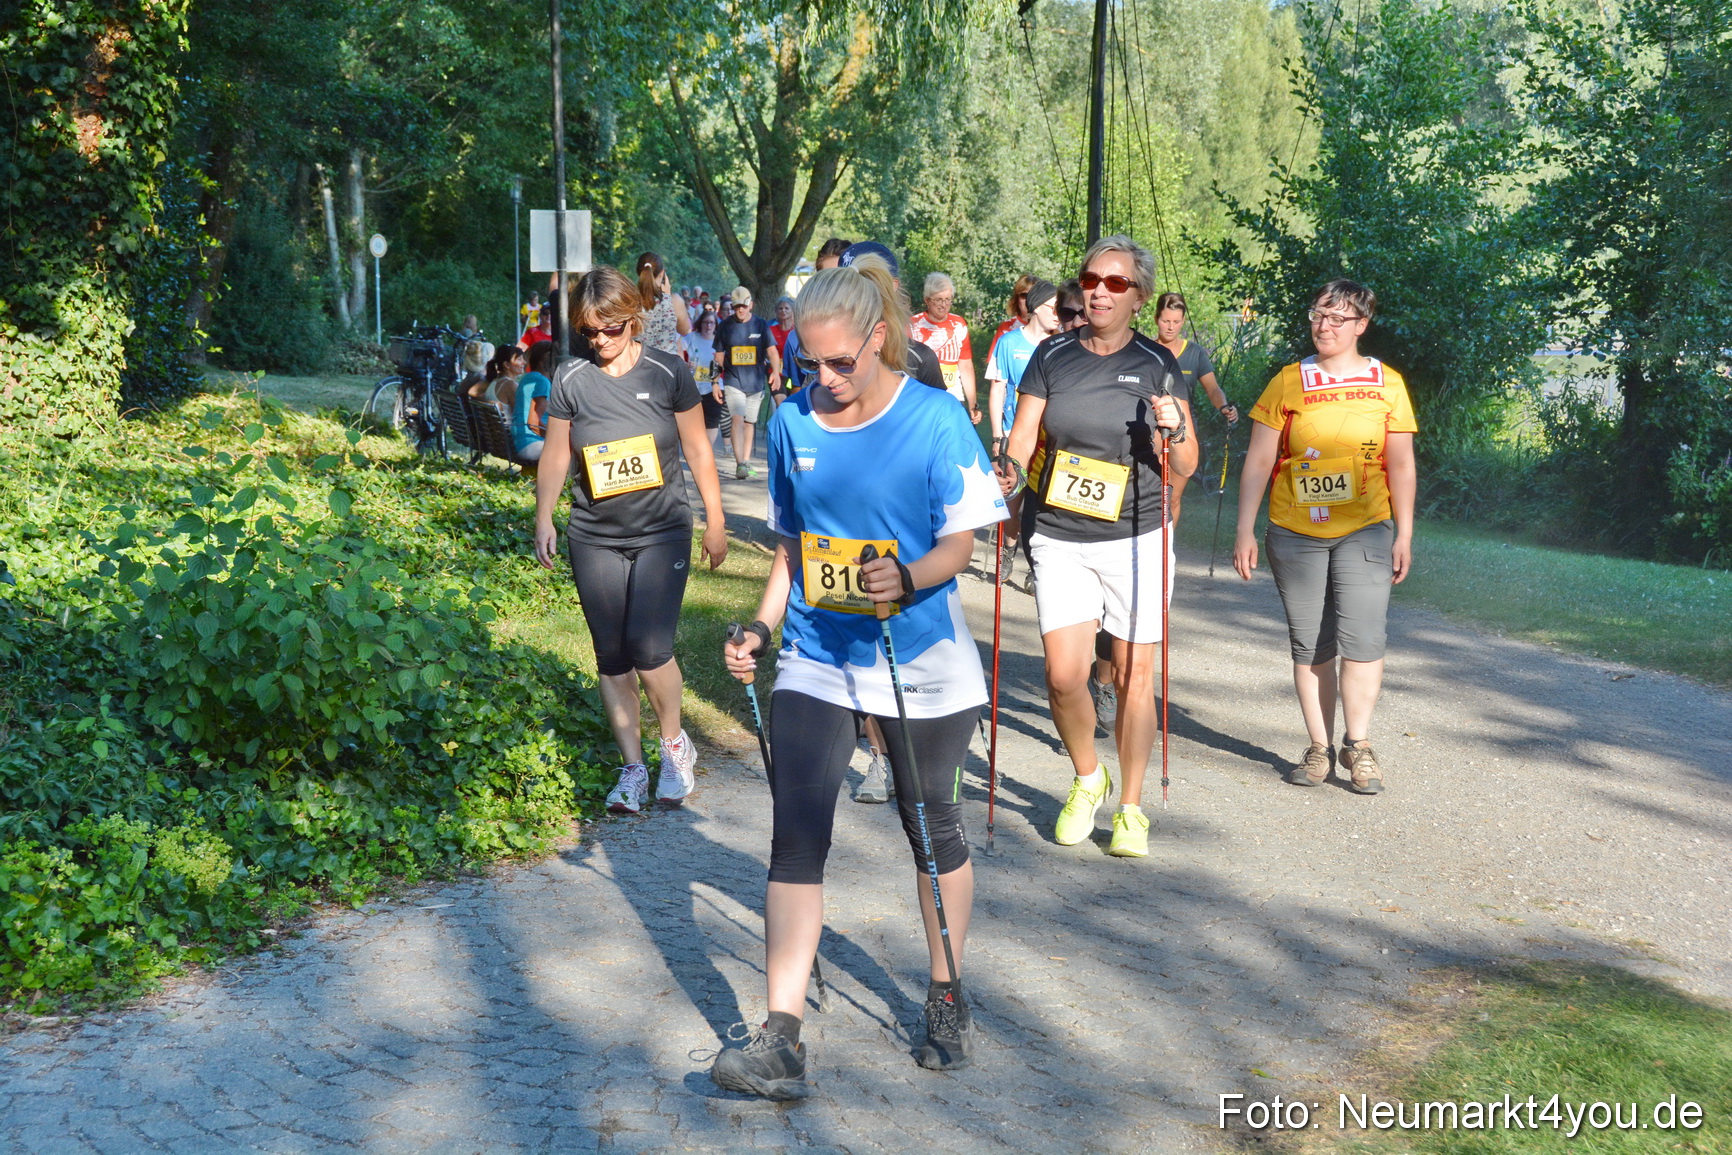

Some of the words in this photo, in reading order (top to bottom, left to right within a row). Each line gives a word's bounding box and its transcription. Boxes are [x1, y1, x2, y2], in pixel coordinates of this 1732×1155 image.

[735, 352, 753, 360] 1093
[1118, 375, 1140, 384] CLAUDIA
[1304, 392, 1340, 405] MAX
[1345, 388, 1385, 401] BÖGL
[603, 456, 643, 480] 748
[1066, 473, 1106, 501] 753
[1300, 474, 1347, 493] 1304
[1078, 498, 1100, 507] Claudia
[826, 590, 845, 600] Pesel
[919, 686, 943, 694] classic
